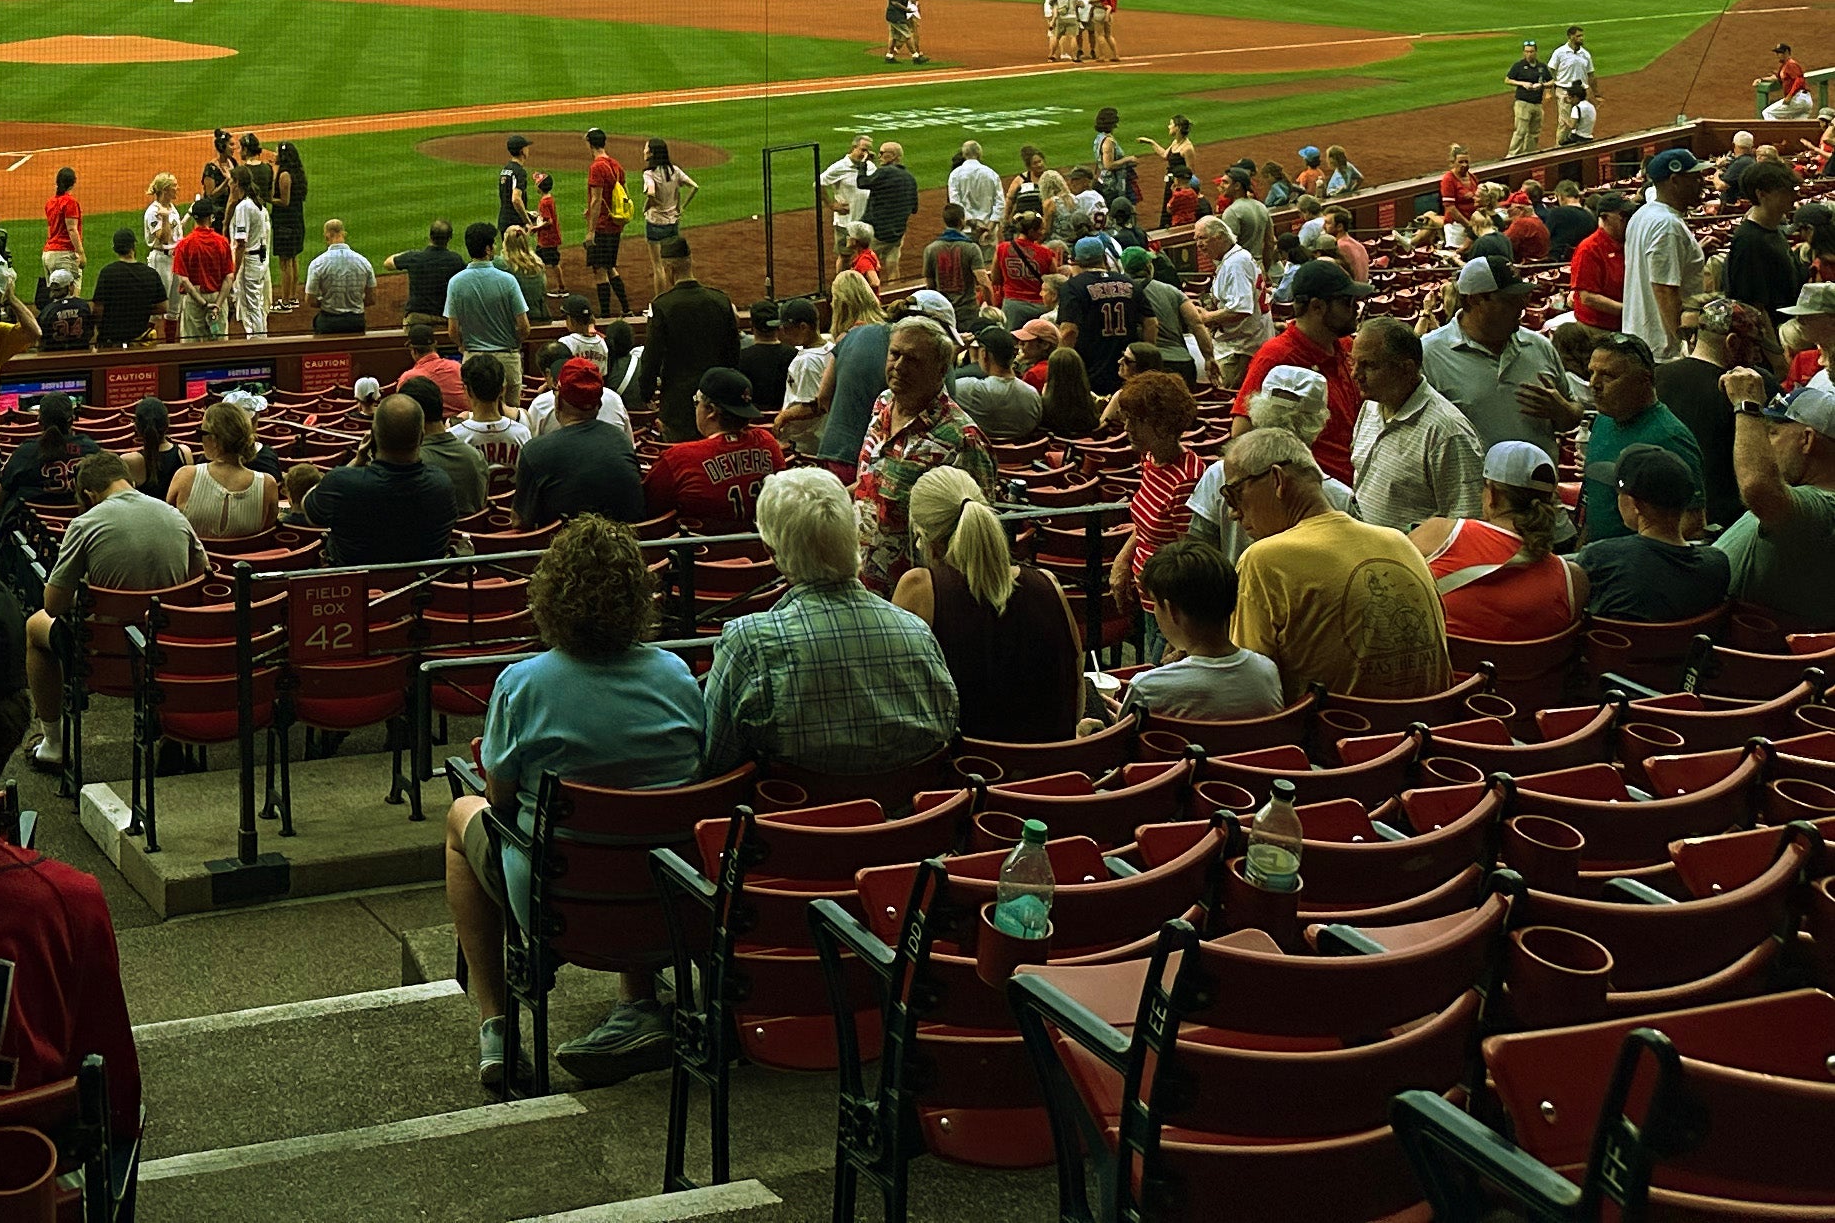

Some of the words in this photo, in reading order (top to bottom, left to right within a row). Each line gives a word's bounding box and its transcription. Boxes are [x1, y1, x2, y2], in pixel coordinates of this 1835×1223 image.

[1086, 281, 1135, 302] DEVERS
[1100, 302, 1128, 338] 11
[304, 357, 350, 369] CAUTION!
[109, 370, 156, 382] CAUTION!
[702, 446, 773, 484] DEVERS
[305, 584, 353, 600] FIELD
[312, 602, 348, 618] BOX
[304, 621, 354, 651] 42
[1147, 1004, 1167, 1036] EE
